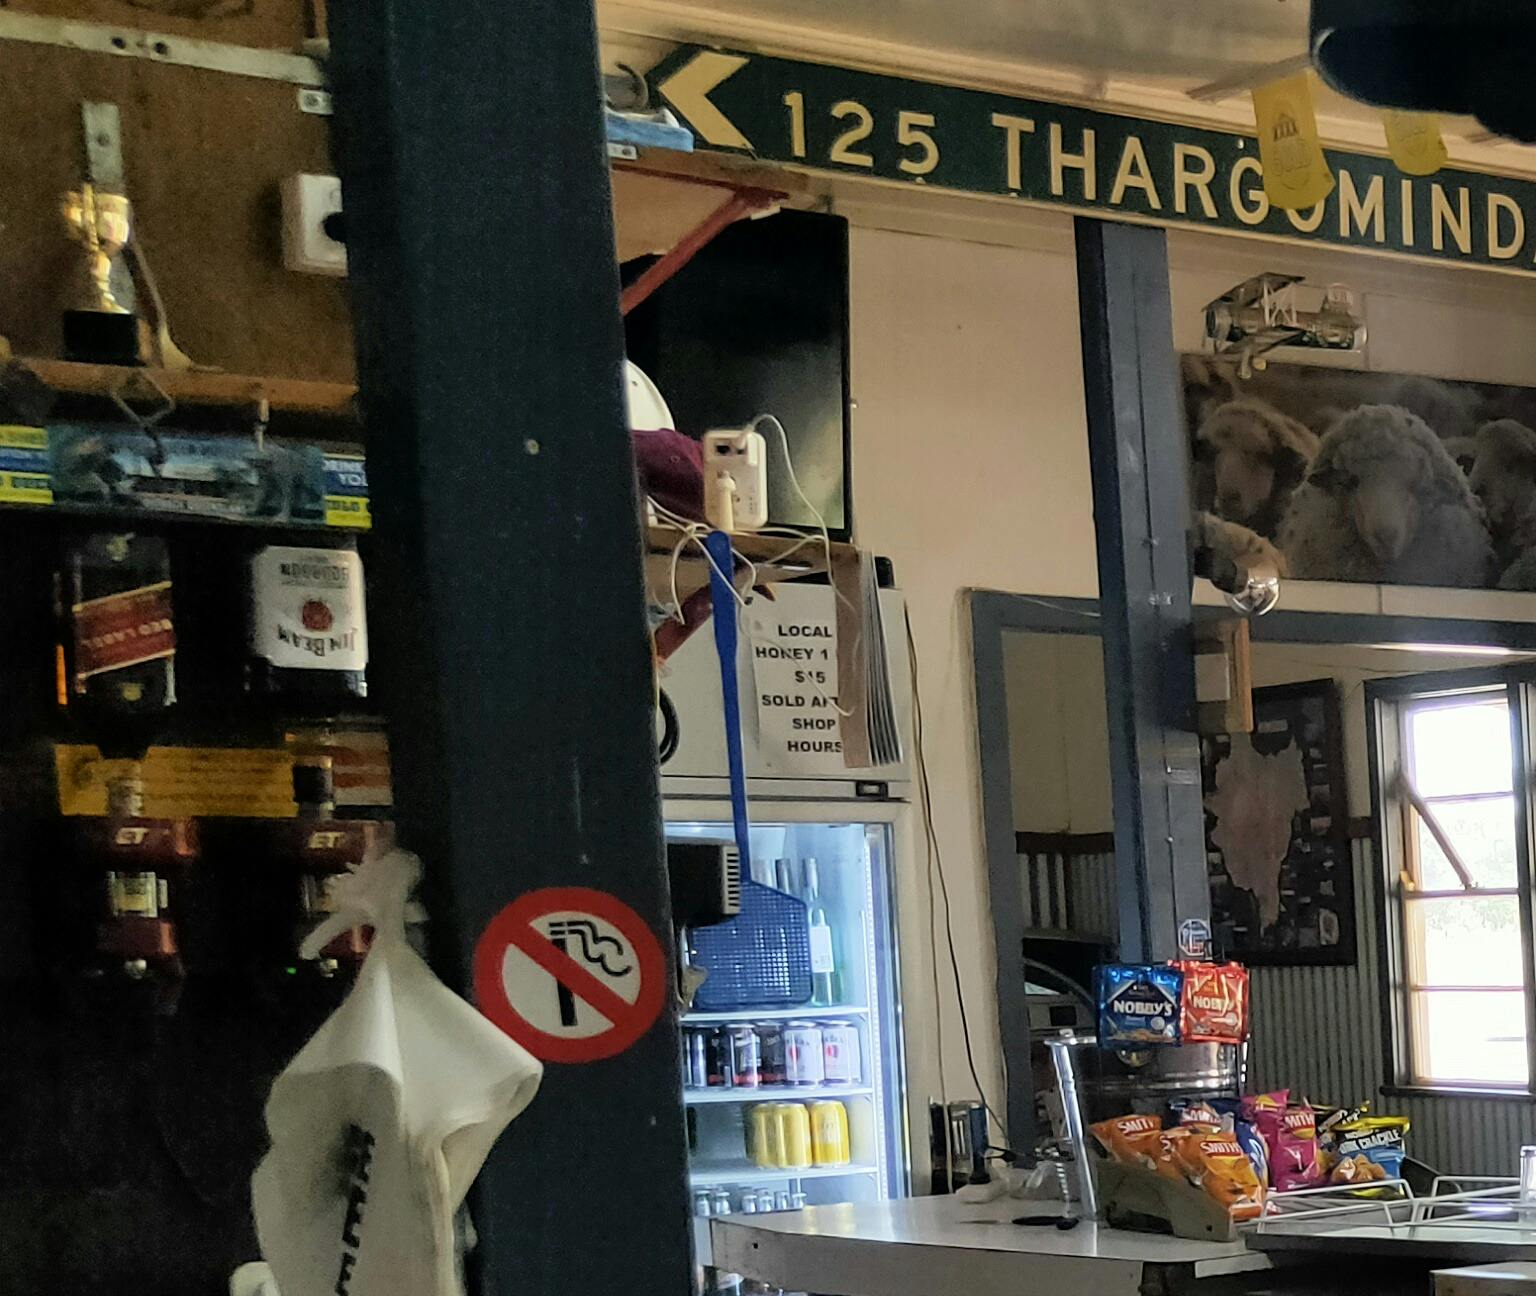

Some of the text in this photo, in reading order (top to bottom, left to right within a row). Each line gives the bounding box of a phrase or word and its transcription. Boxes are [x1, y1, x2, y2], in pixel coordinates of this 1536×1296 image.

[781, 90, 941, 177] 125
[778, 625, 833, 637] LOCAL
[756, 647, 813, 659] HONEY
[762, 695, 805, 707] SOLD
[792, 718, 835, 729] SHOP
[787, 741, 843, 752] HOURS
[1113, 1000, 1173, 1017] NOBBY'S
